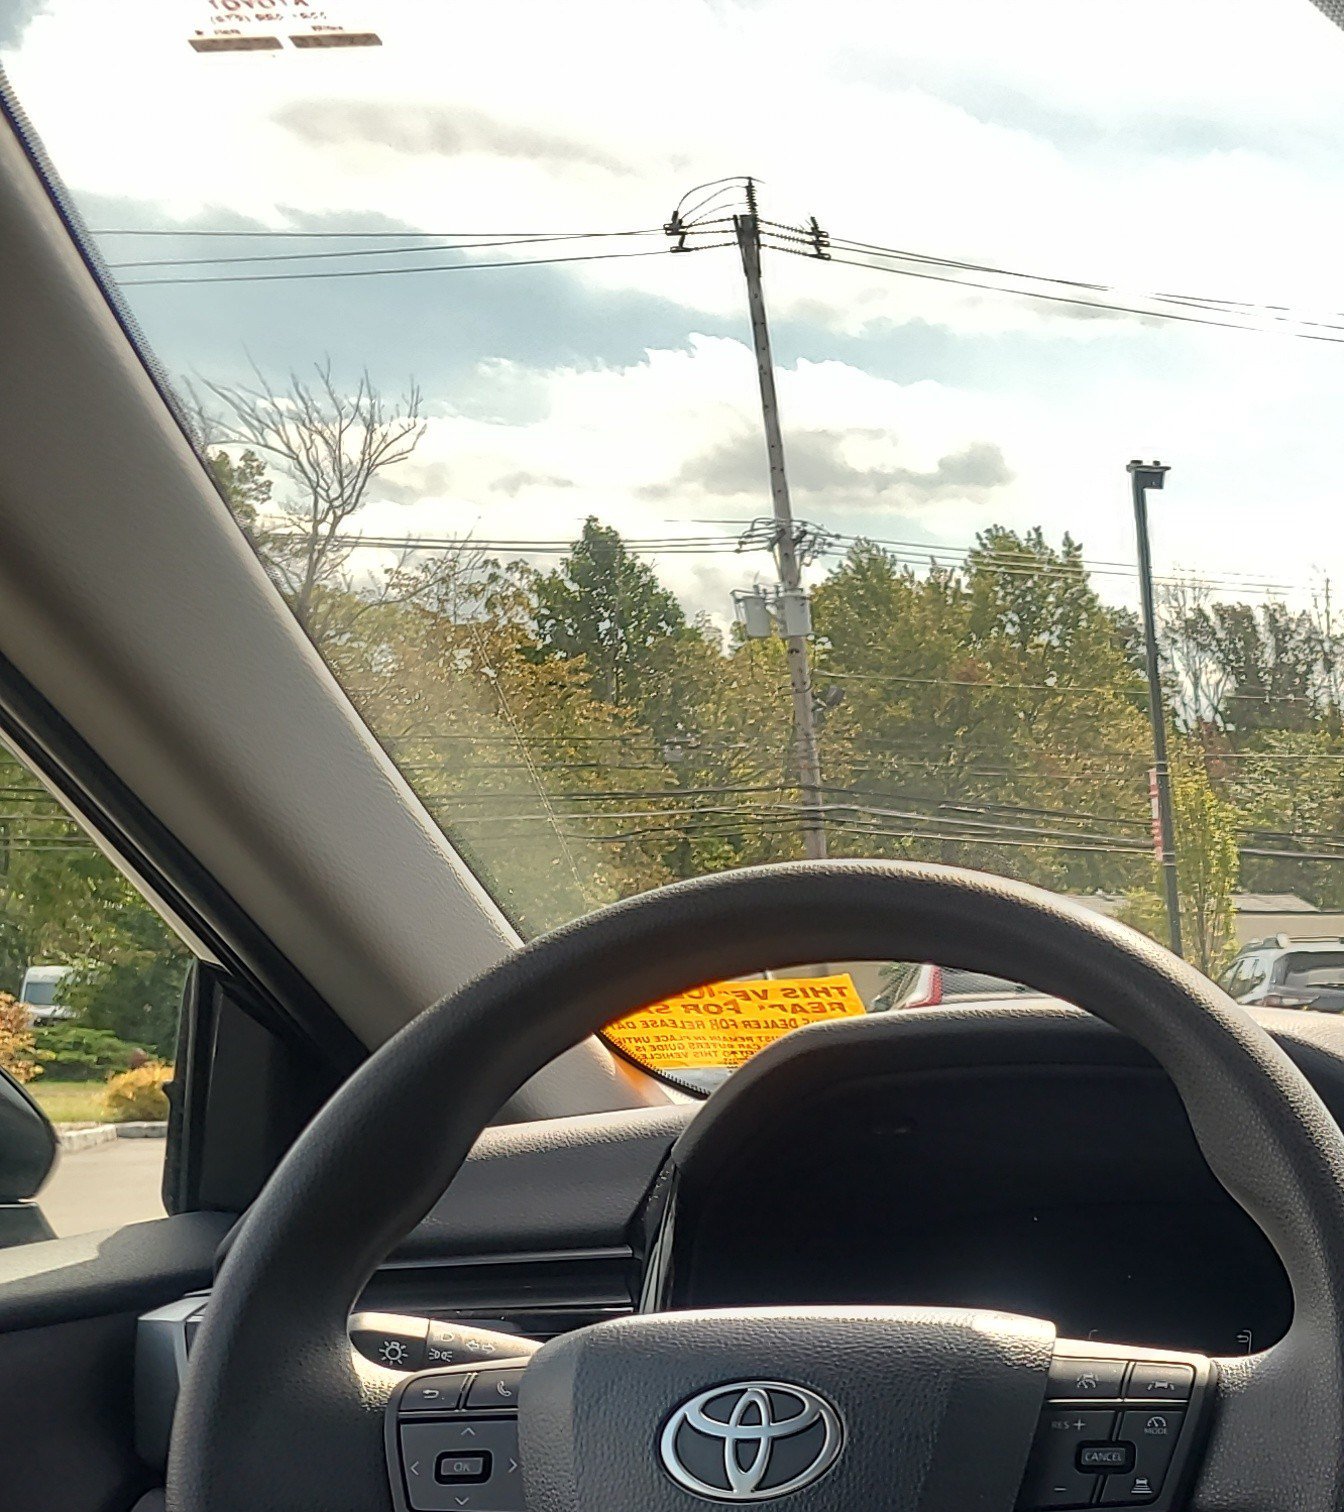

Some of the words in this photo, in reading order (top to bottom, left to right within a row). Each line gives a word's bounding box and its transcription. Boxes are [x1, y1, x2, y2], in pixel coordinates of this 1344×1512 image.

[1144, 1427, 1168, 1435] MODE
[1085, 1451, 1122, 1462] CANCEL
[453, 1461, 471, 1473] OK
